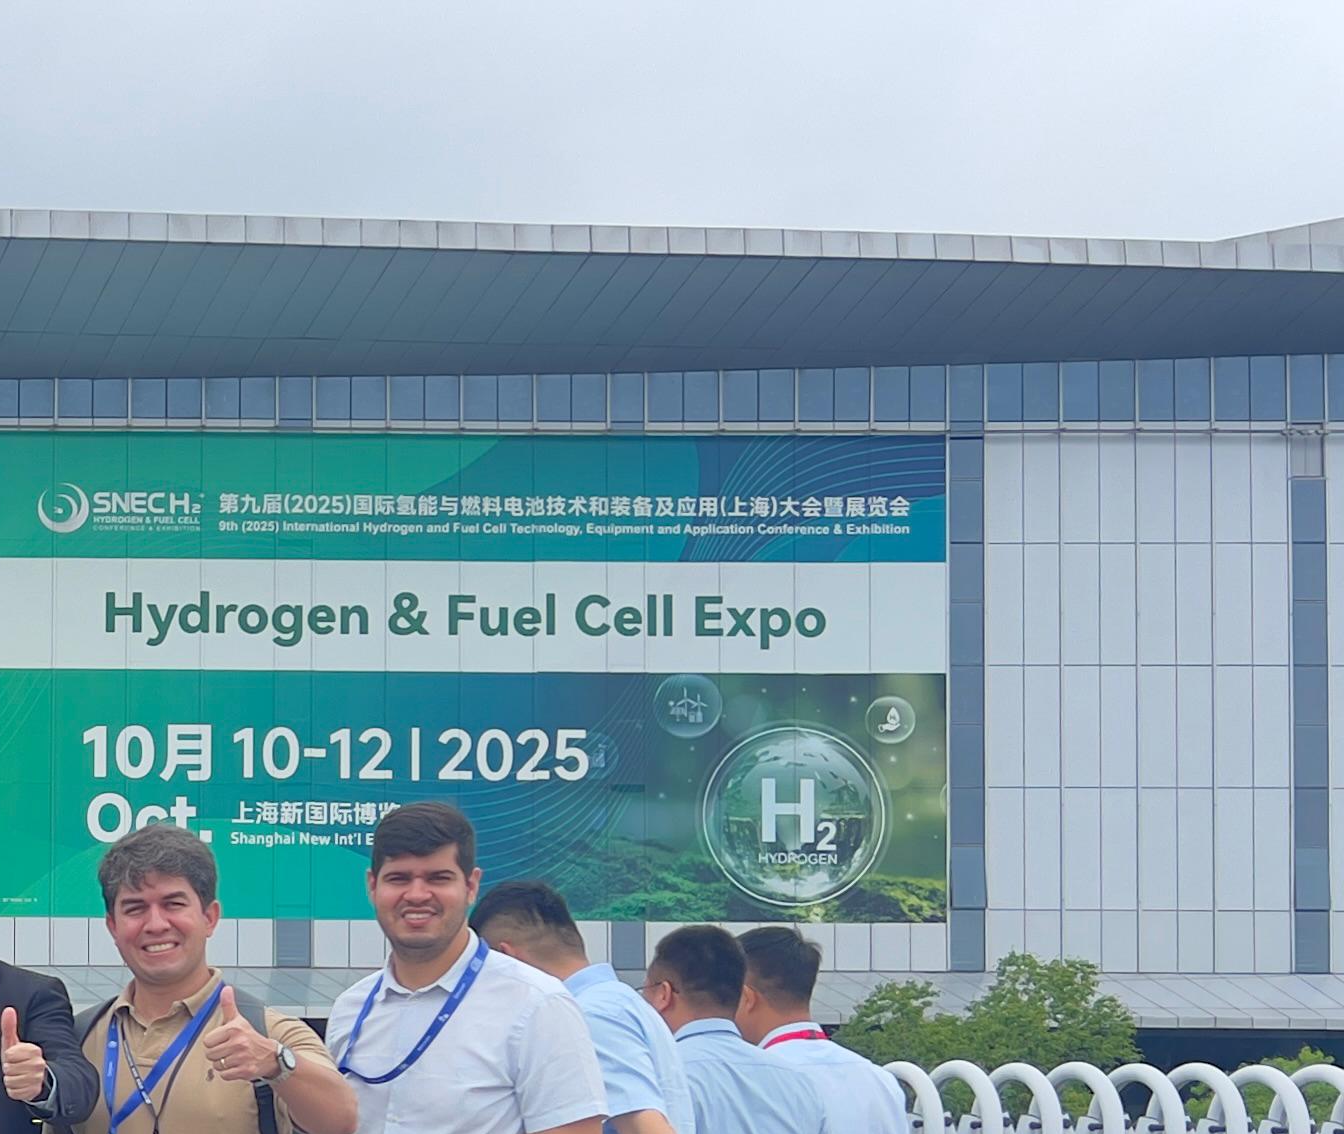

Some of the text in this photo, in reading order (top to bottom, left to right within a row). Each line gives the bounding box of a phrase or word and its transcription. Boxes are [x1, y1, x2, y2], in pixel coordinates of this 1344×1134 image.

[92, 491, 165, 514] SNEC
[218, 492, 910, 518] 第九届(2025)国际氢能与燃料电池技术和装备及应用(上海)大会暨展览会
[92, 516, 144, 525] HYDROGEN
[155, 516, 176, 525] FUEL
[178, 516, 201, 526] CELL
[218, 520, 911, 537] 9th (2025) International Hydrogen and Fuel Cell Technology, Equipment and Application Conference & Exhibition
[104, 590, 827, 651] Hydrogen & Fuel Cell Expo
[82, 723, 213, 782] 10月
[232, 725, 393, 780] 10-12
[438, 728, 590, 782] 2025
[230, 831, 296, 848] Shanghai
[299, 832, 331, 846] New
[334, 832, 361, 847] Int'l
[758, 853, 839, 866] HYDROGEN
